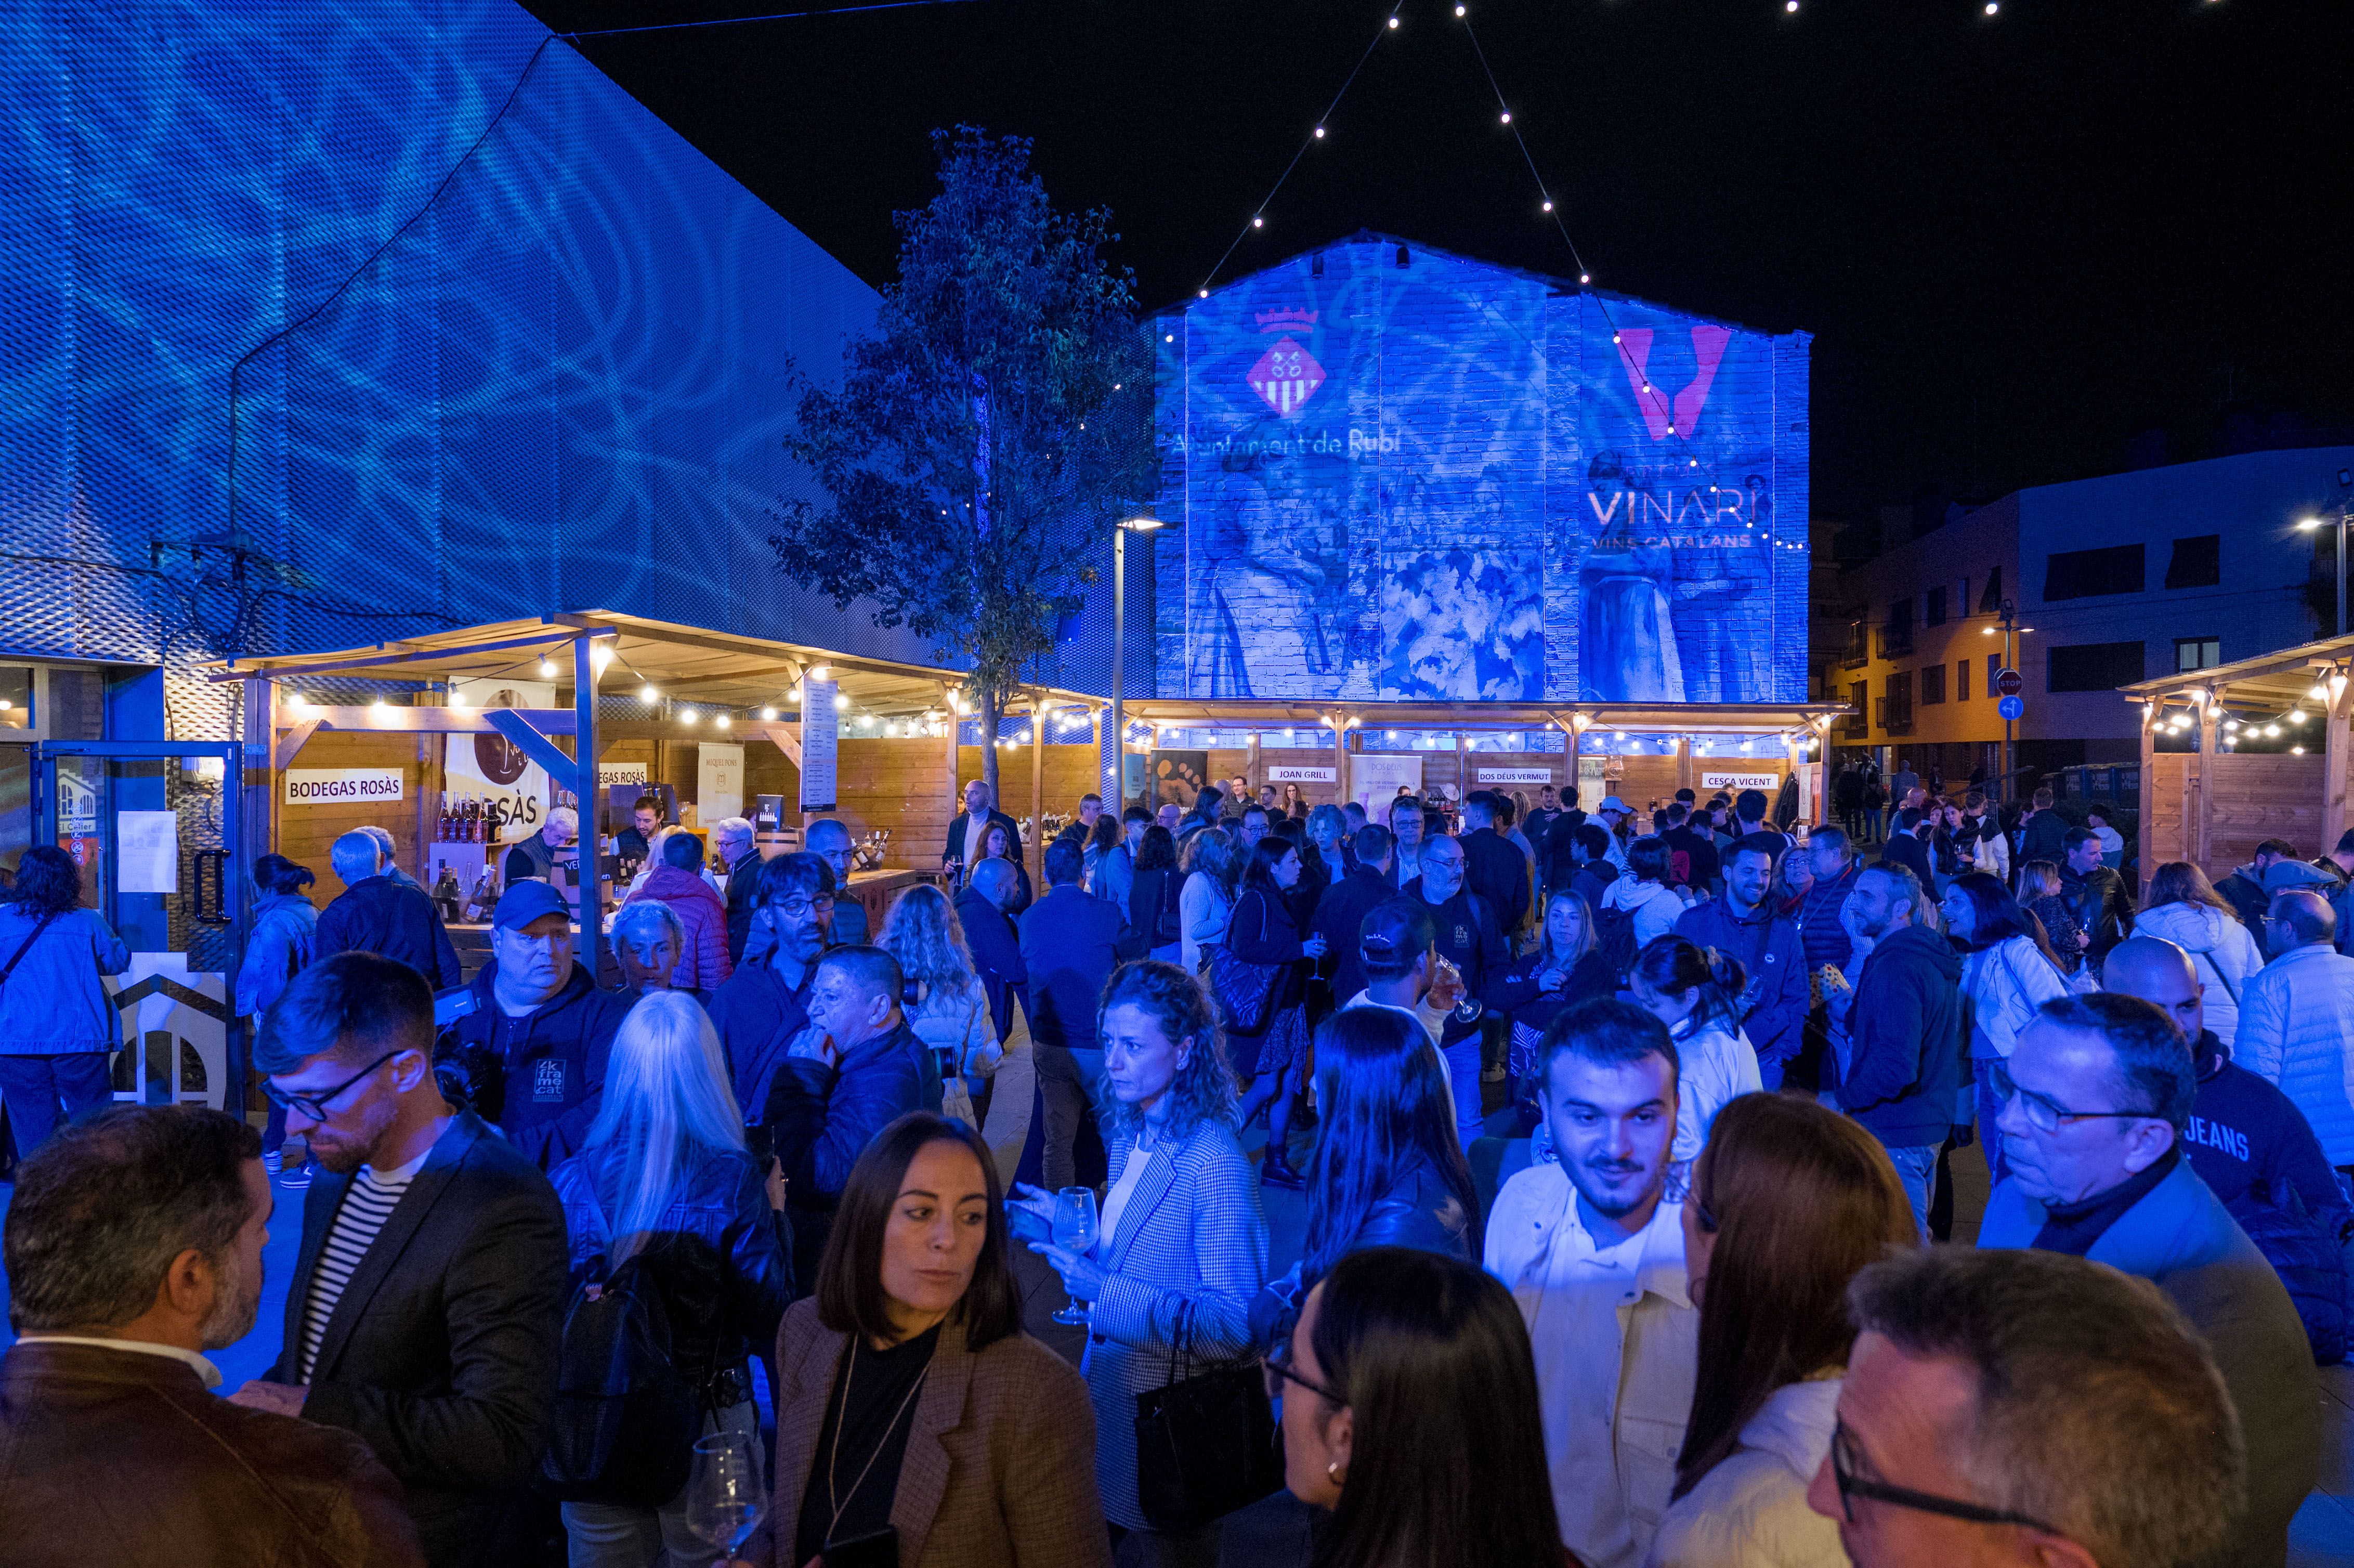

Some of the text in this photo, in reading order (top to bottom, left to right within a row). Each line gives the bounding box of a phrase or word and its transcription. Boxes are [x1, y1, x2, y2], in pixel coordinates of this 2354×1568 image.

[1313, 430, 1342, 453] de
[1588, 489, 1756, 525] VINARI
[1592, 535, 1751, 549] VINS CATALANS
[706, 758, 724, 767] MIQUEL
[1371, 763, 1385, 771] DOS
[598, 769, 645, 783] EGAS ROSÀS
[1497, 772, 1516, 780] DÉUS
[1708, 777, 1736, 786] CESCA
[290, 776, 399, 798] BODEGAS ROSÀS
[539, 1061, 558, 1070] 4k
[539, 1069, 561, 1078] fra
[2184, 1115, 2250, 1162] JEANS
